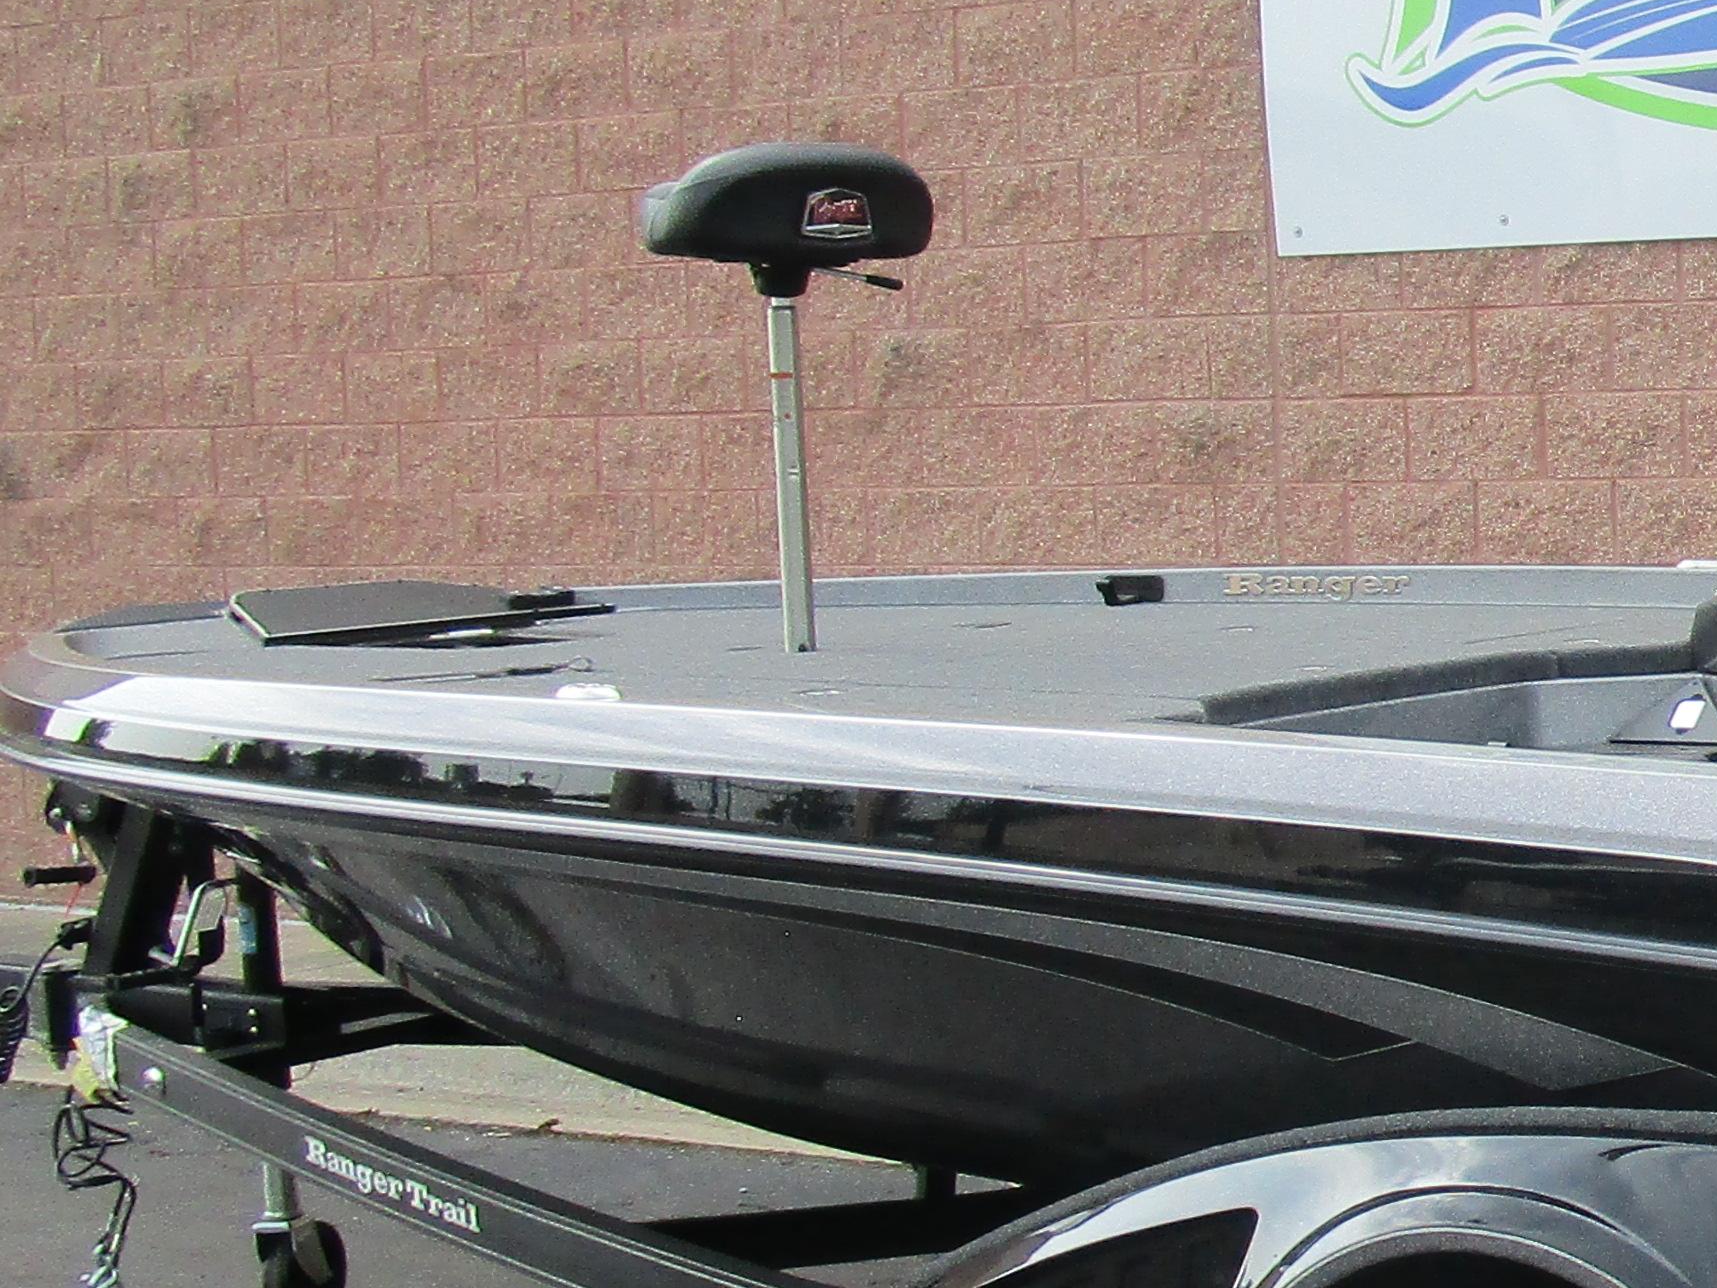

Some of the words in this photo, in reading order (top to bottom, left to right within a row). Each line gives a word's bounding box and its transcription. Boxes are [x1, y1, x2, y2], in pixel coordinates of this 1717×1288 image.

[1222, 572, 1411, 601] Ranger
[303, 1134, 405, 1201] Ranger
[404, 1177, 482, 1234] Trail
